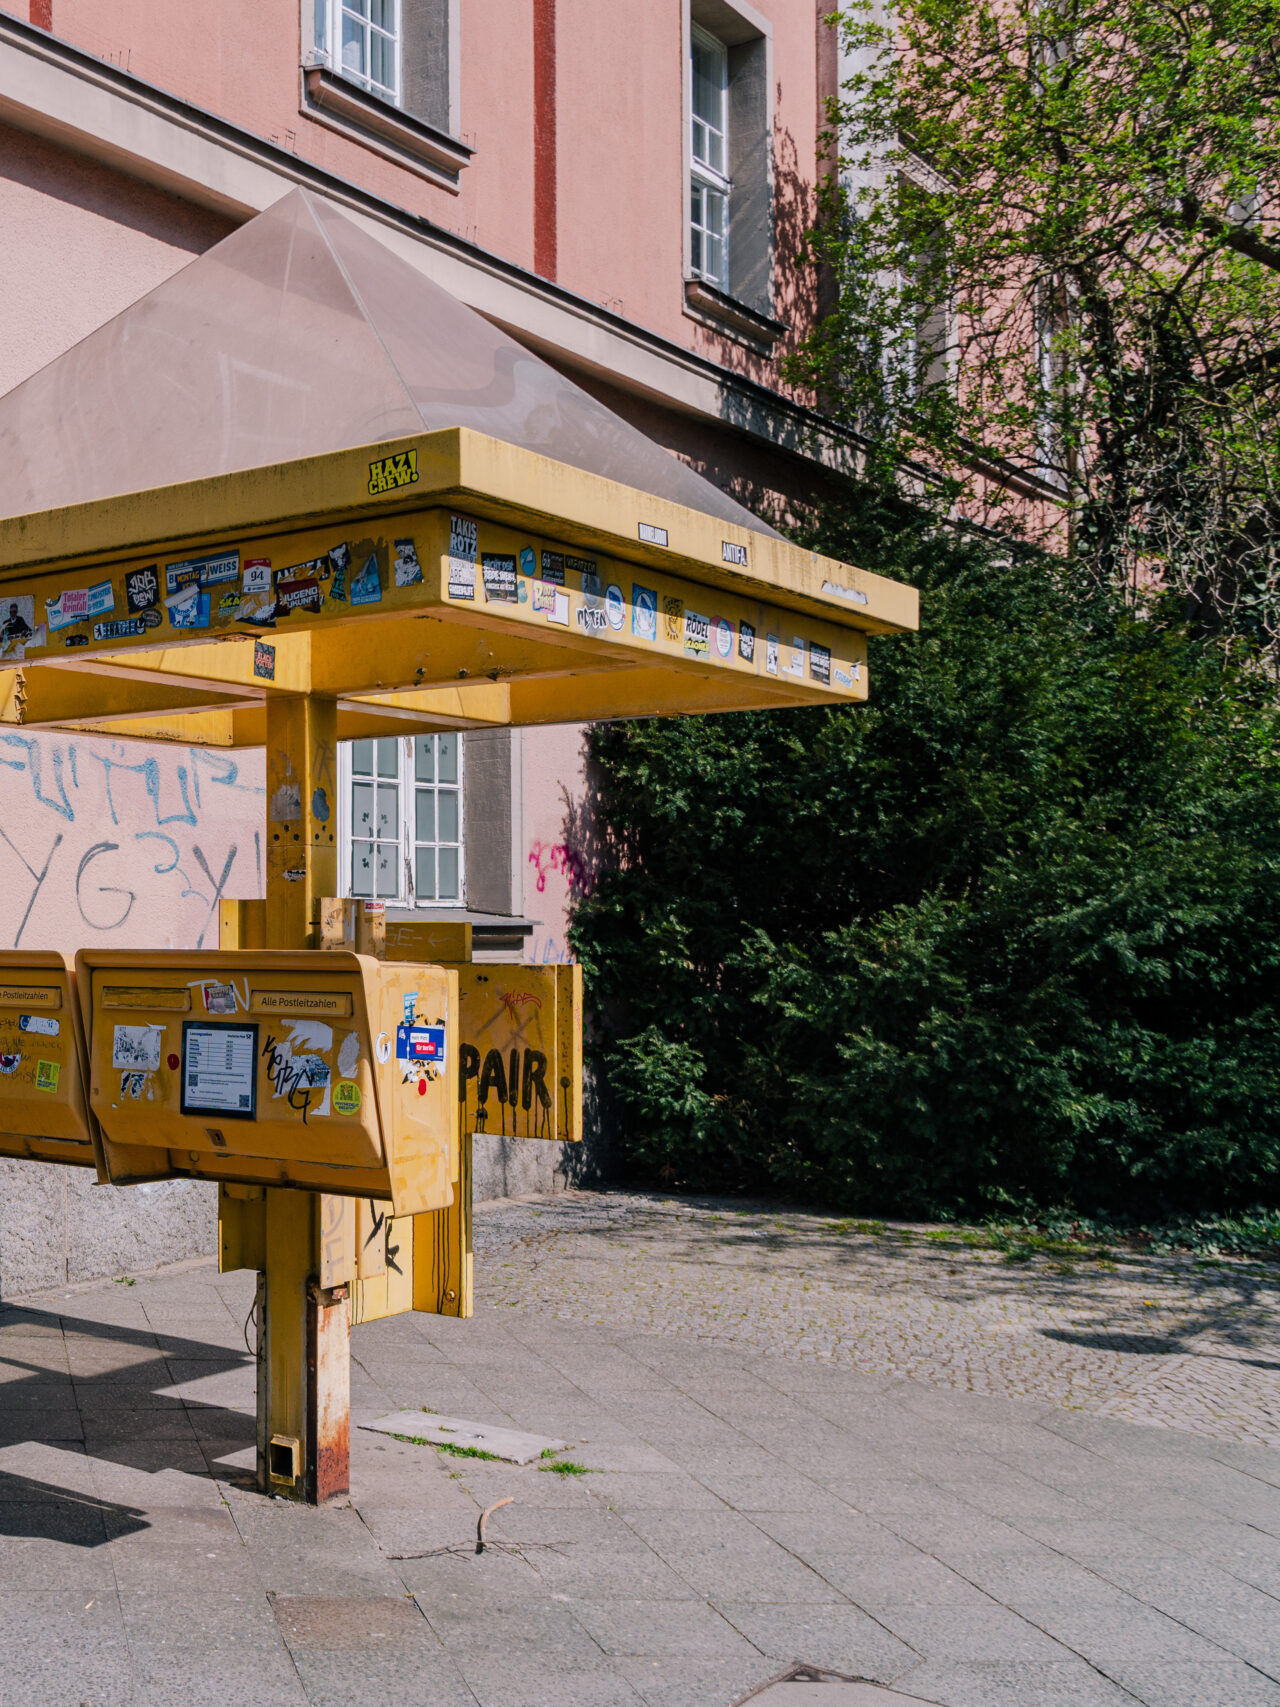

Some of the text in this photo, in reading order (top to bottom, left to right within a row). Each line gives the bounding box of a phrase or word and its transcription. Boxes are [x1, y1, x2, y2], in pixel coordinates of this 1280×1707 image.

[450, 516, 477, 539] TAKIS
[450, 533, 477, 555] ROTZ
[210, 560, 237, 576] WEISS
[250, 570, 264, 582] 94
[63, 591, 87, 602] Totaler
[63, 602, 87, 613] Reinfall
[2, 991, 49, 1001] Postleitzahlen
[261, 996, 337, 1010] Alle Postleitzahlen
